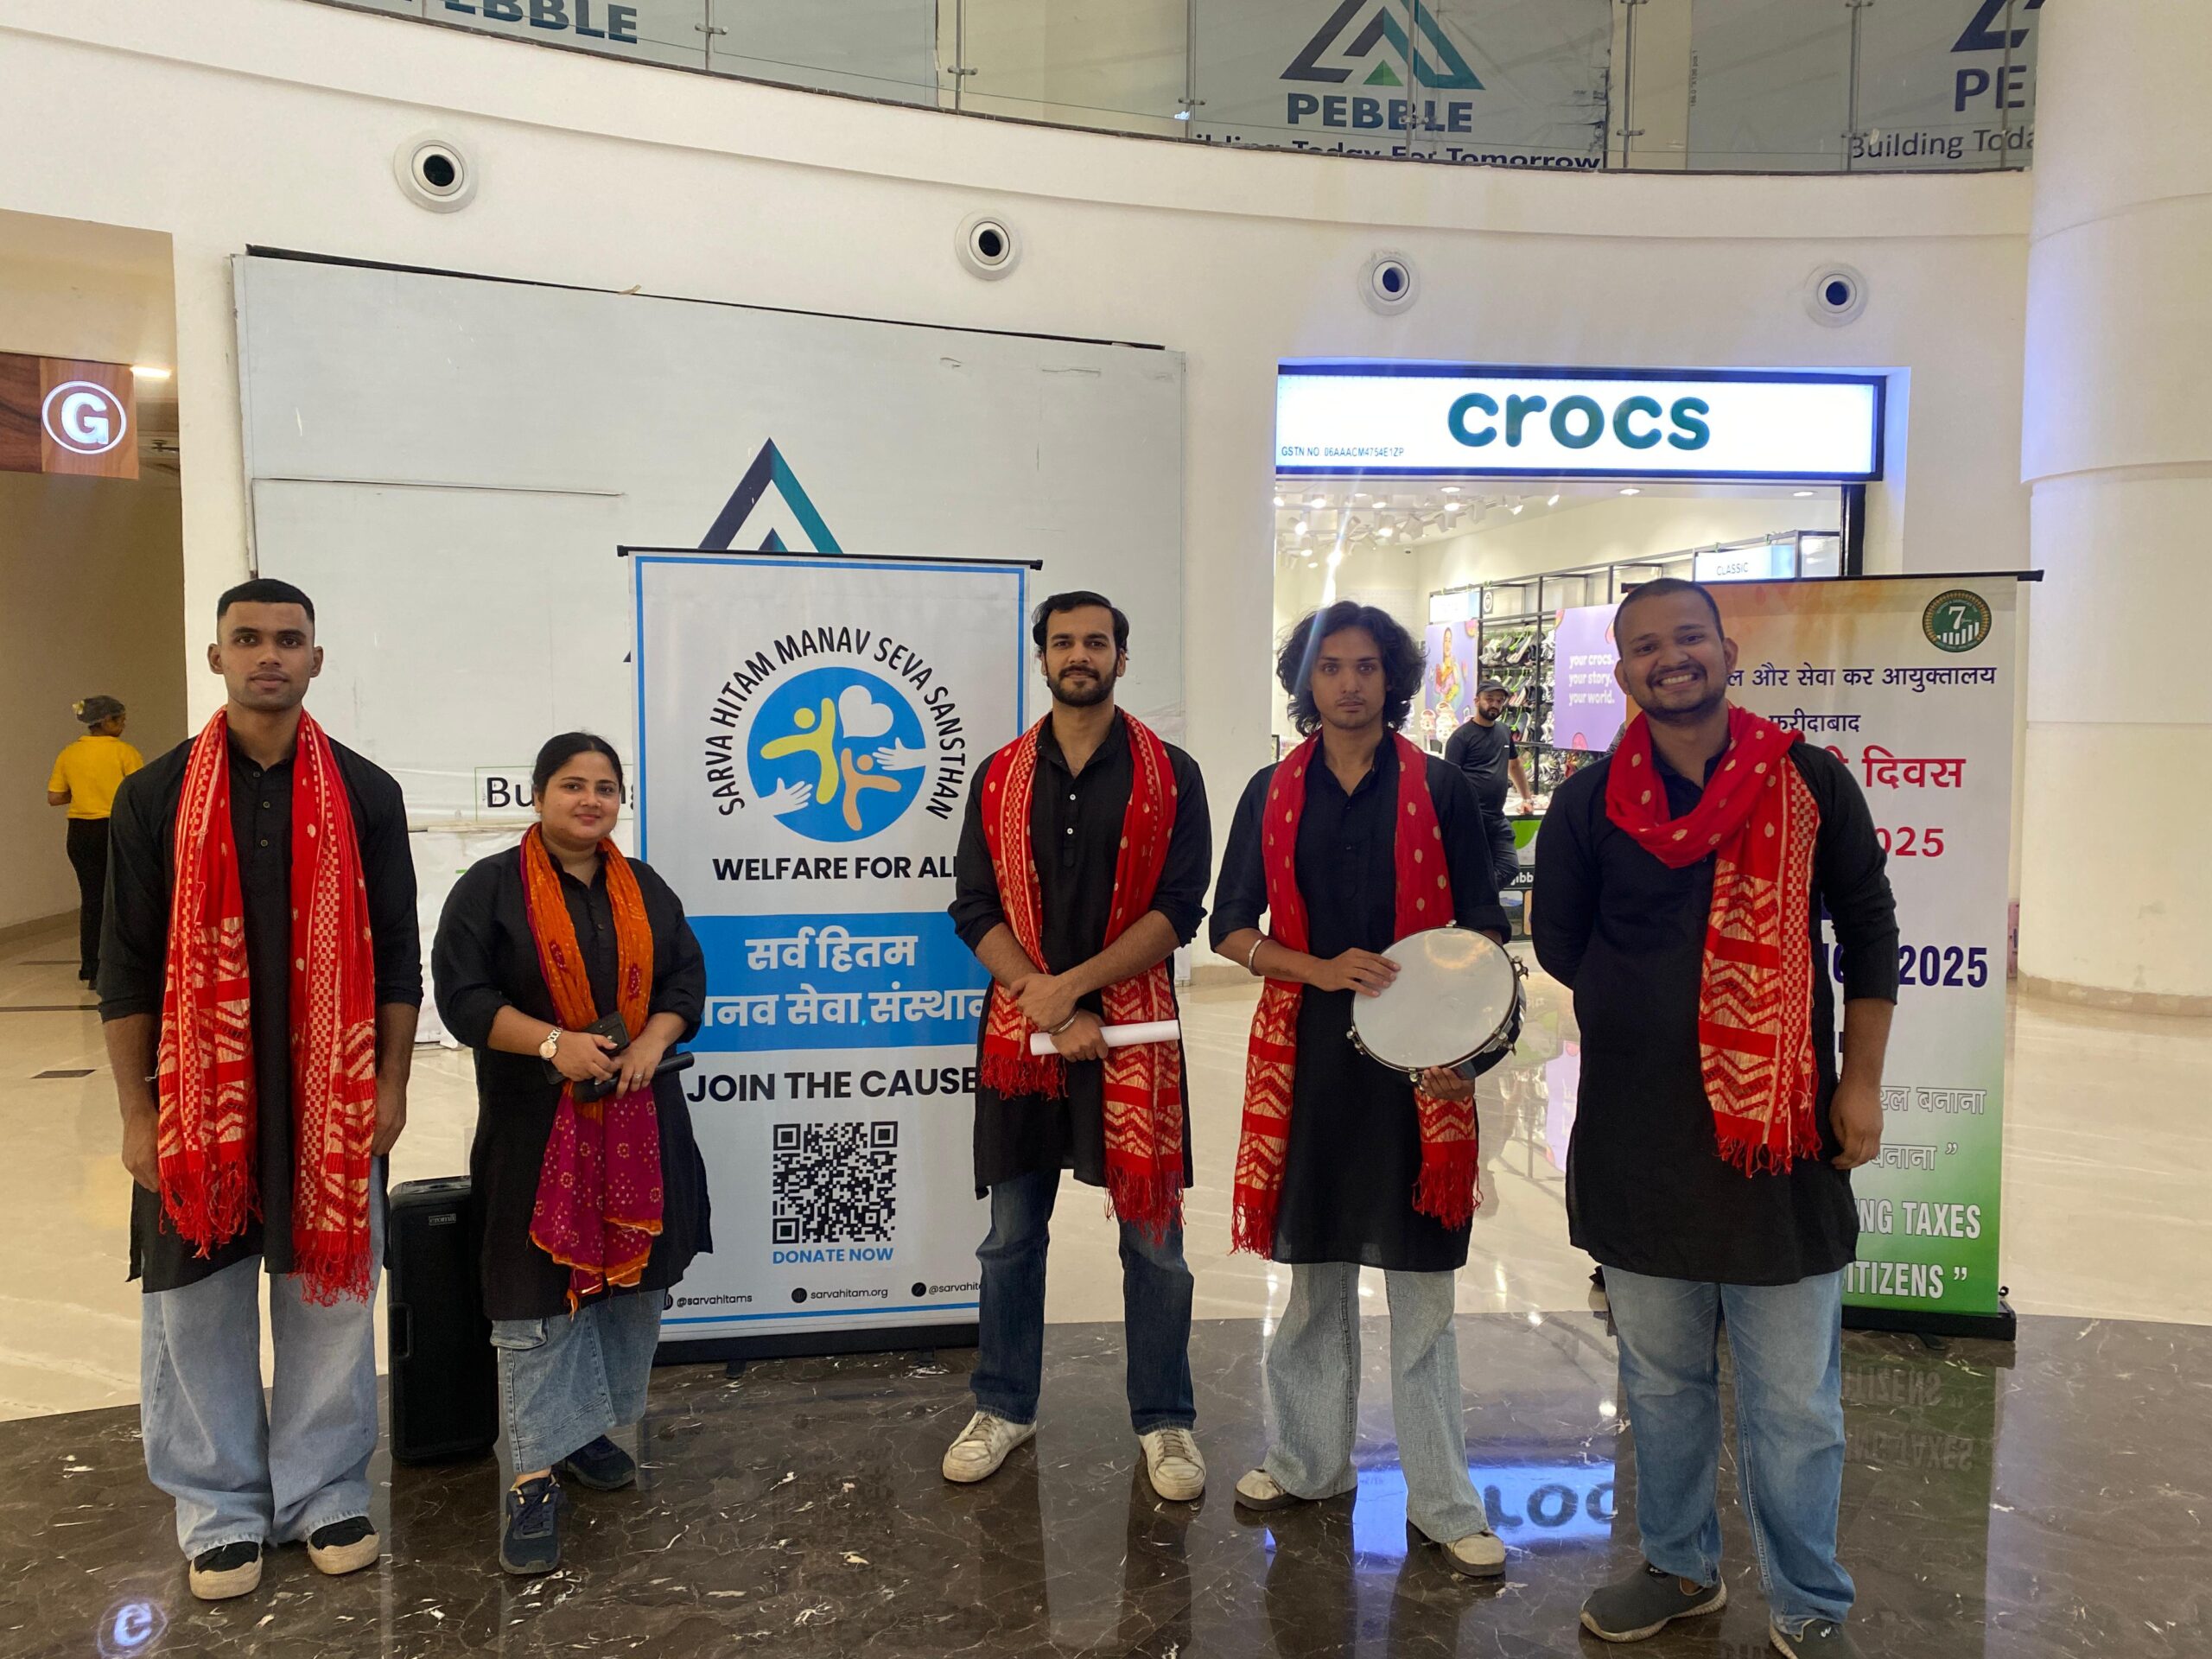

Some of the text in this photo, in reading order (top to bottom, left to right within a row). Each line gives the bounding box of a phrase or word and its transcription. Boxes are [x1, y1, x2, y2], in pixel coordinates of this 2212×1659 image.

[1287, 92, 1474, 133] PEBBLE
[1853, 132, 1963, 159] Building
[61, 392, 109, 445] G
[1448, 392, 1710, 451] crocs
[1281, 446, 1305, 456] GSTN
[1716, 562, 1749, 575] CLASSIC
[1948, 607, 1966, 630] 7
[1568, 653, 1615, 670] your crocs.
[1568, 671, 1613, 688] your story.
[1752, 662, 1790, 686] और
[1796, 662, 1836, 687] सेवा
[1843, 669, 1874, 685] कर
[1882, 666, 1997, 693] आयुक्तालय
[1568, 690, 1615, 707] your world.
[705, 626, 966, 820] SARVA HITAM MANAV SEVA SANSTHAN
[1861, 745, 1967, 790] दिवस
[713, 856, 957, 880] WELFARE FOR AL
[745, 925, 918, 972] सर्व हितम
[1898, 944, 1988, 988] 2025
[785, 983, 862, 1025] सेवा
[687, 1066, 976, 1103] JOIN THE CAUSE
[1916, 1086, 1987, 1116] बनाना
[1855, 1198, 1981, 1240] NG TAXES
[772, 1247, 893, 1265] DONATE NOW
[1844, 1260, 1944, 1300] ITIZENS
[677, 1294, 753, 1308] @sarvahitams
[810, 1287, 888, 1301] sarvahitam.org
